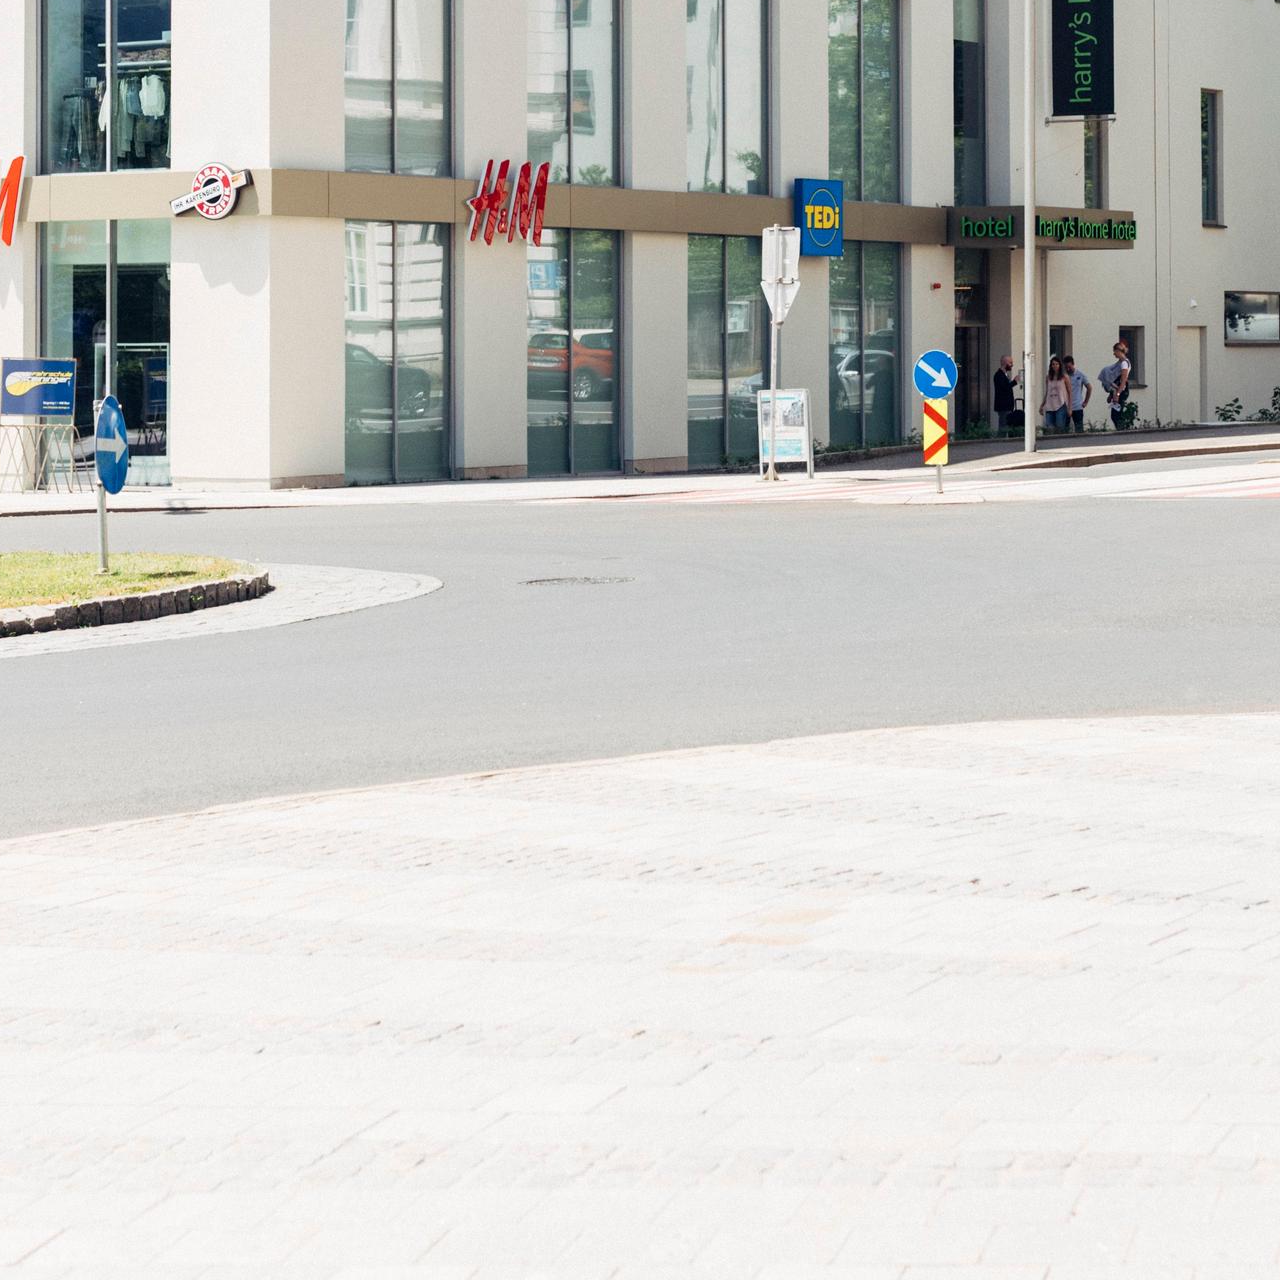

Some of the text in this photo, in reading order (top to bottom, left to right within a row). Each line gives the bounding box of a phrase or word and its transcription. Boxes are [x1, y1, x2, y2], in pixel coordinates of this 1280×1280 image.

[1068, 10, 1098, 103] harry's
[193, 166, 226, 189] TABAK
[202, 186, 232, 216] TRAFIK
[466, 159, 550, 247] H&M
[804, 205, 840, 230] TEDi
[961, 215, 1015, 238] hotel
[1036, 215, 1077, 242] harry's
[1077, 217, 1109, 239] home
